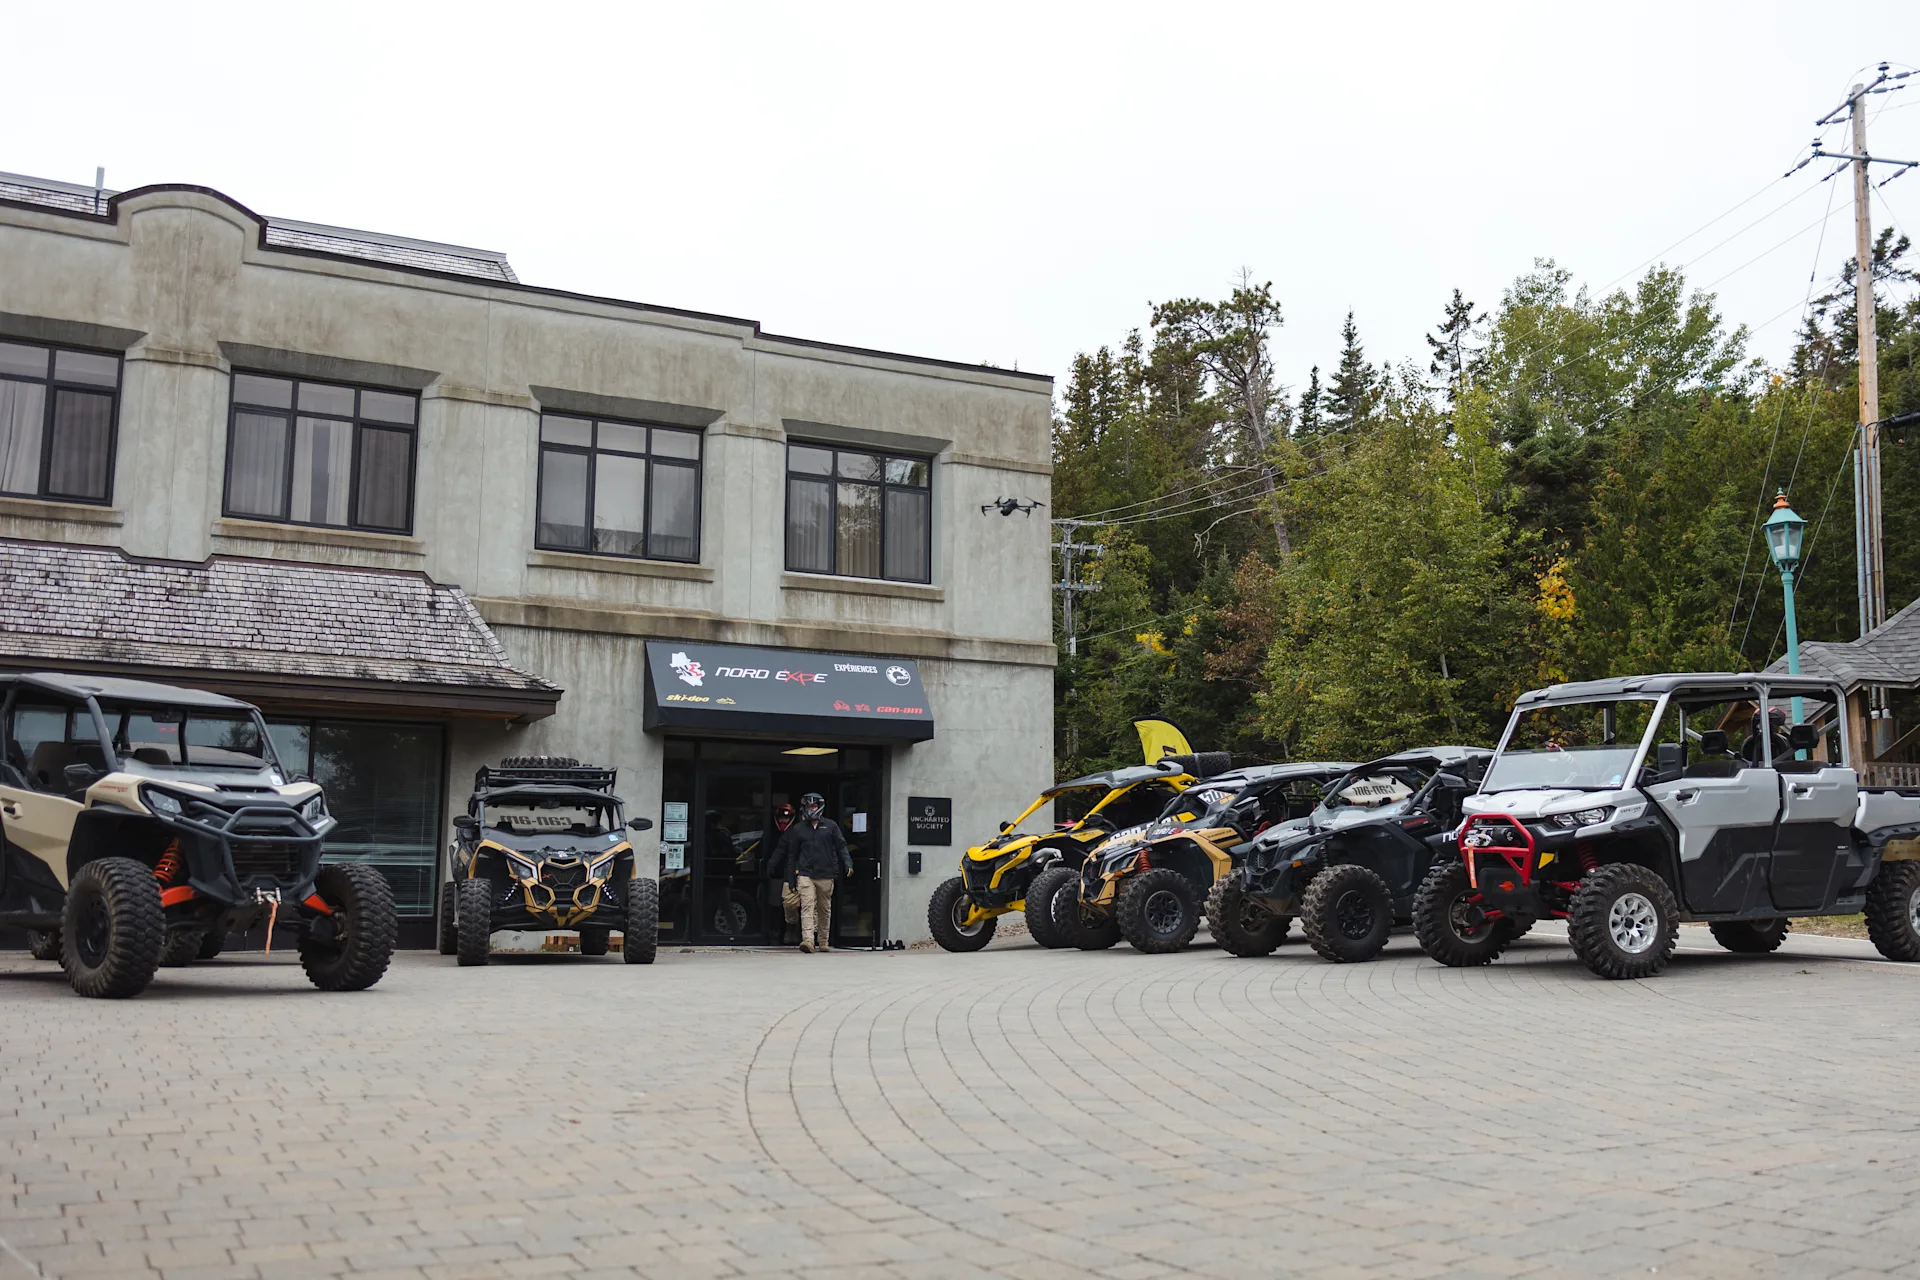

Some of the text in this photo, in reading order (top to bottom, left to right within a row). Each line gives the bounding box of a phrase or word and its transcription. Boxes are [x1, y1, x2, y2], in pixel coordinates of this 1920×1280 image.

[833, 663, 878, 674] EXPÉRIENCES
[715, 666, 828, 686] NORD EXPE
[666, 694, 710, 702] ski-doo
